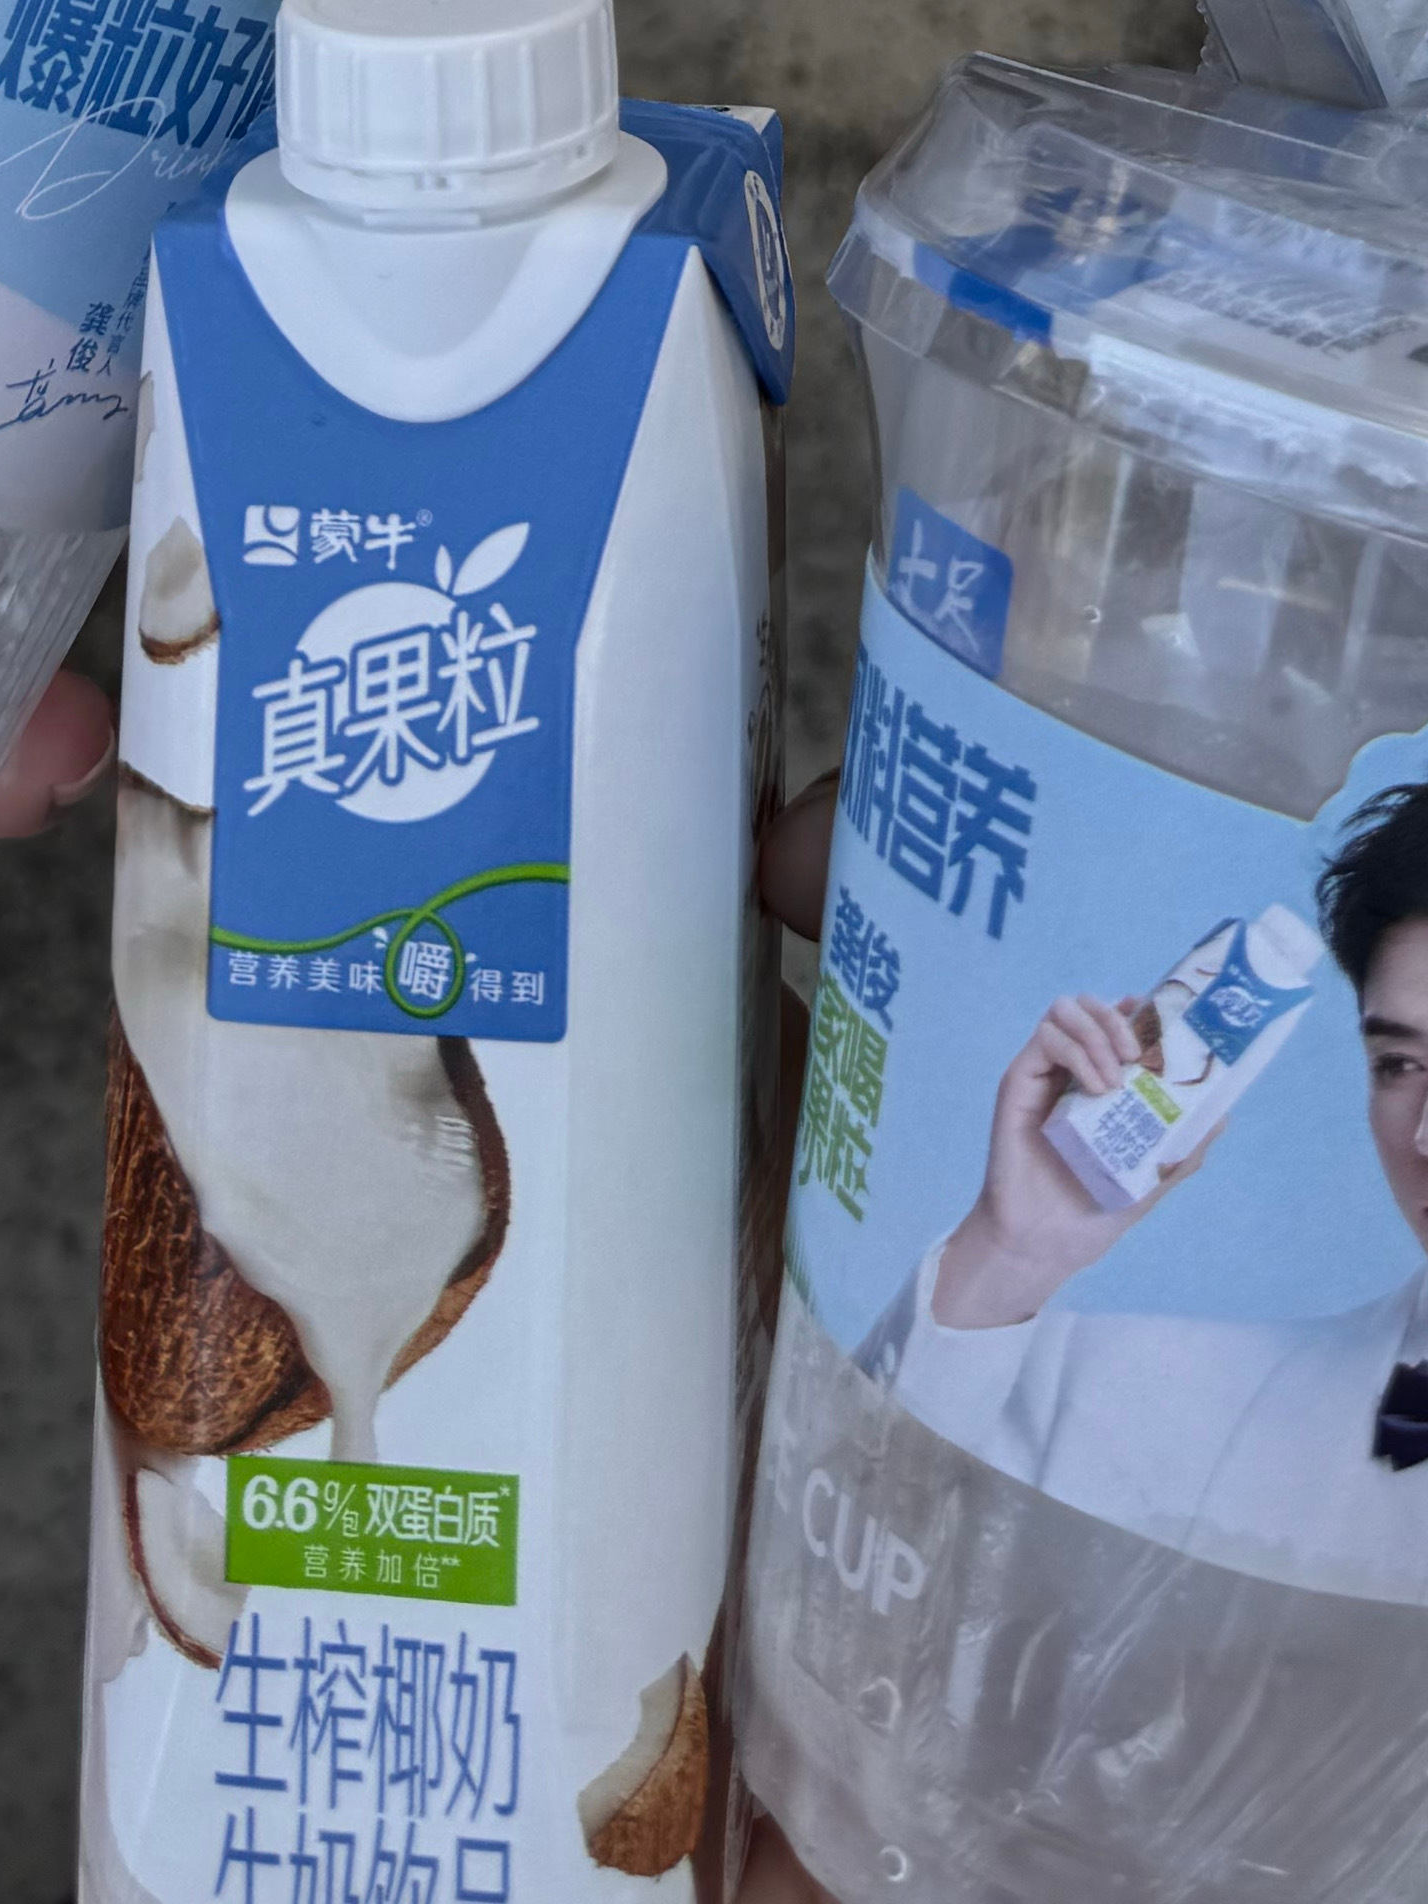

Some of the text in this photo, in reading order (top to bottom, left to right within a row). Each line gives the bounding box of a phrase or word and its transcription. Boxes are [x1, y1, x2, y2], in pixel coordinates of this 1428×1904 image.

[64, 300, 115, 374] 龚俊
[243, 602, 541, 819] 真果粒
[213, 1611, 521, 1822] 生榨椰奶
